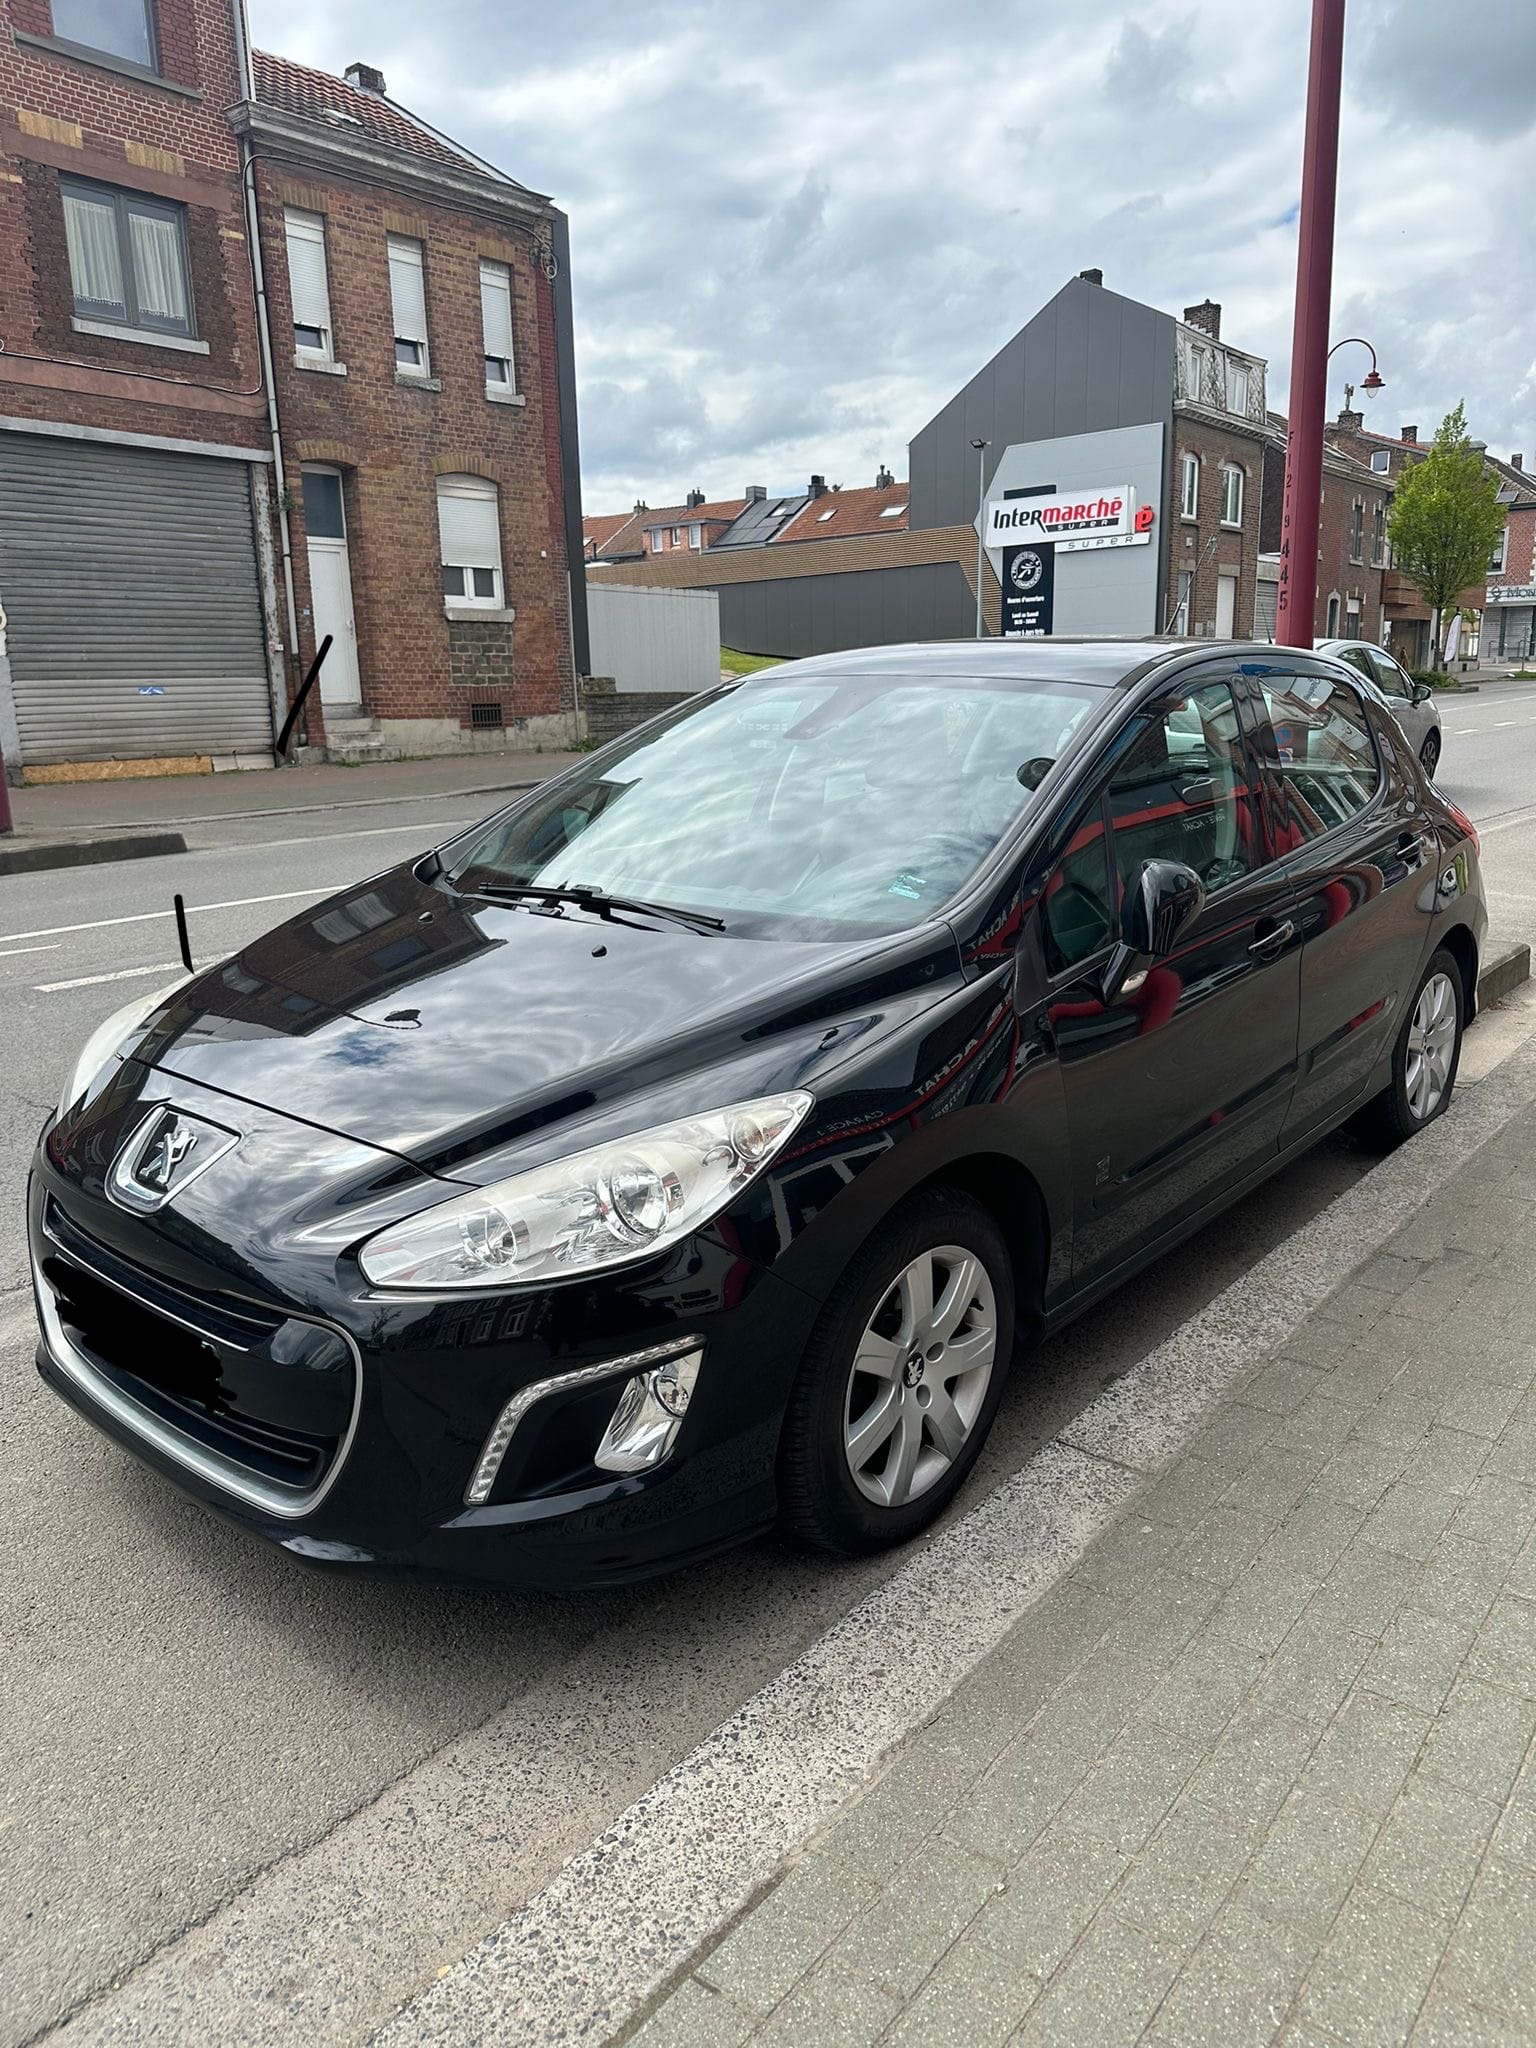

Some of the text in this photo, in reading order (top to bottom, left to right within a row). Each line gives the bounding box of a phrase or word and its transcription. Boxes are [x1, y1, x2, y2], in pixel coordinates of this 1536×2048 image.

[993, 496, 1123, 534] Intermarché
[1057, 519, 1108, 531] SUPER
[1067, 536, 1134, 550] SUPER
